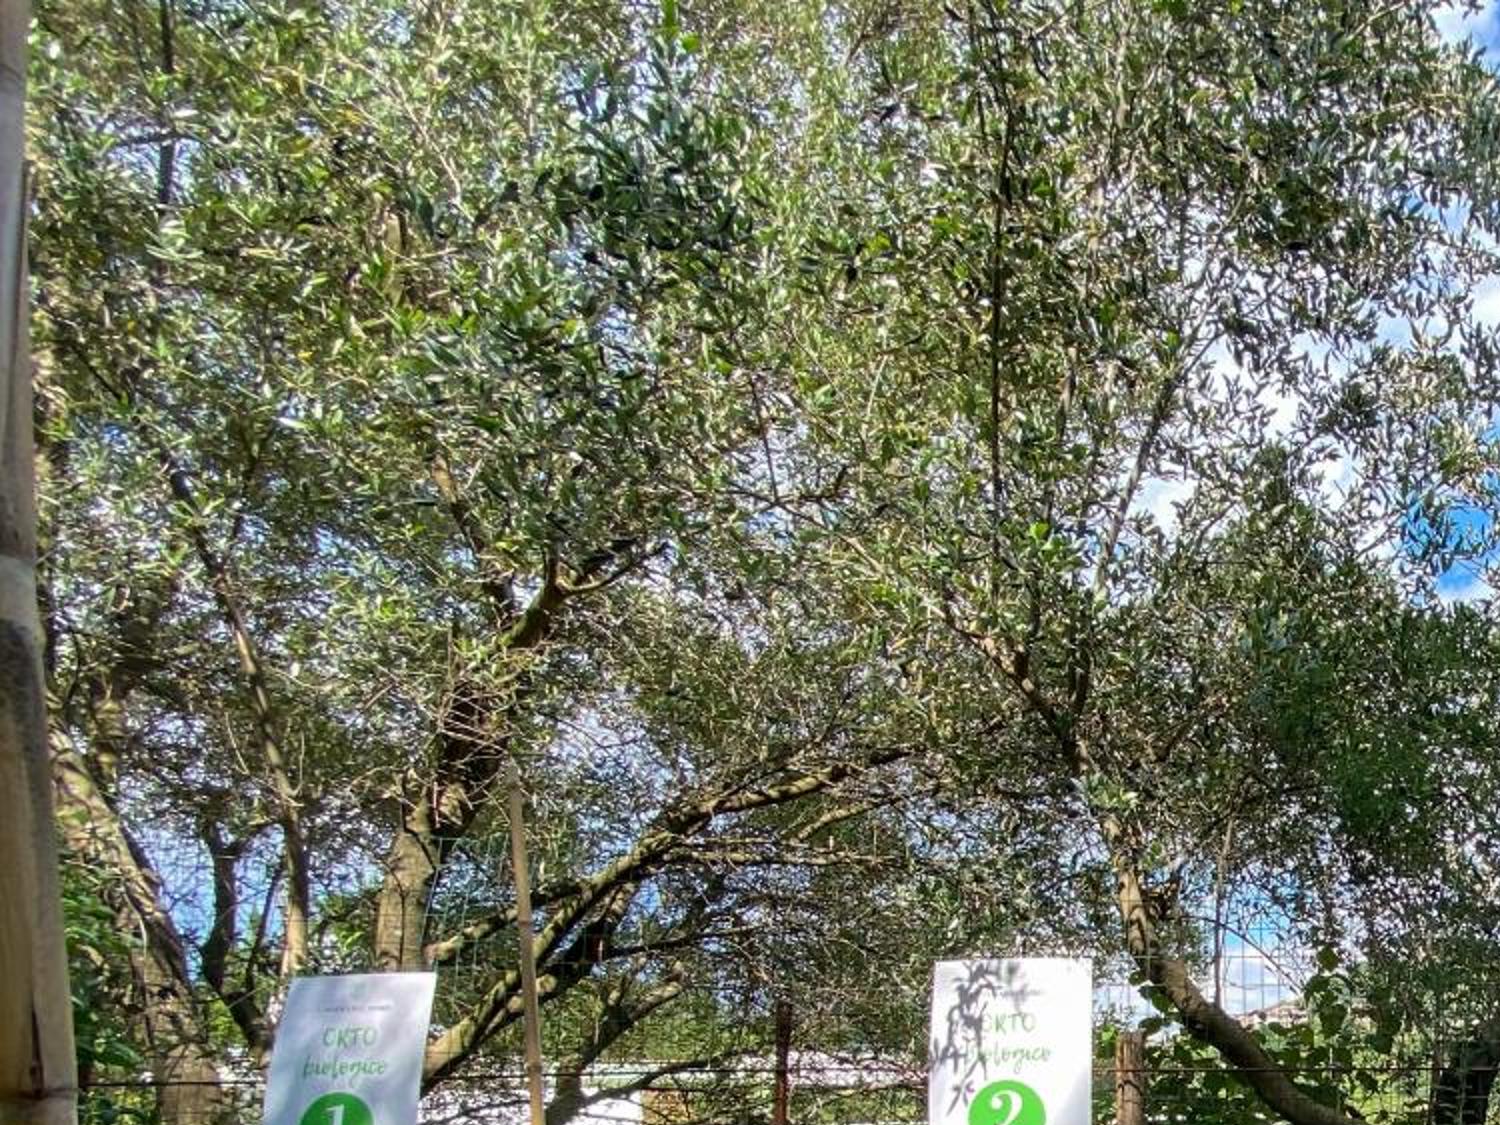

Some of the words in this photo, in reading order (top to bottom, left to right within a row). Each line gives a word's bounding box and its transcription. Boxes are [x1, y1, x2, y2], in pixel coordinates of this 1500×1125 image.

[322, 1026, 376, 1047] ORTO
[303, 1052, 386, 1088] biologico
[965, 1041, 1051, 1074] bologico
